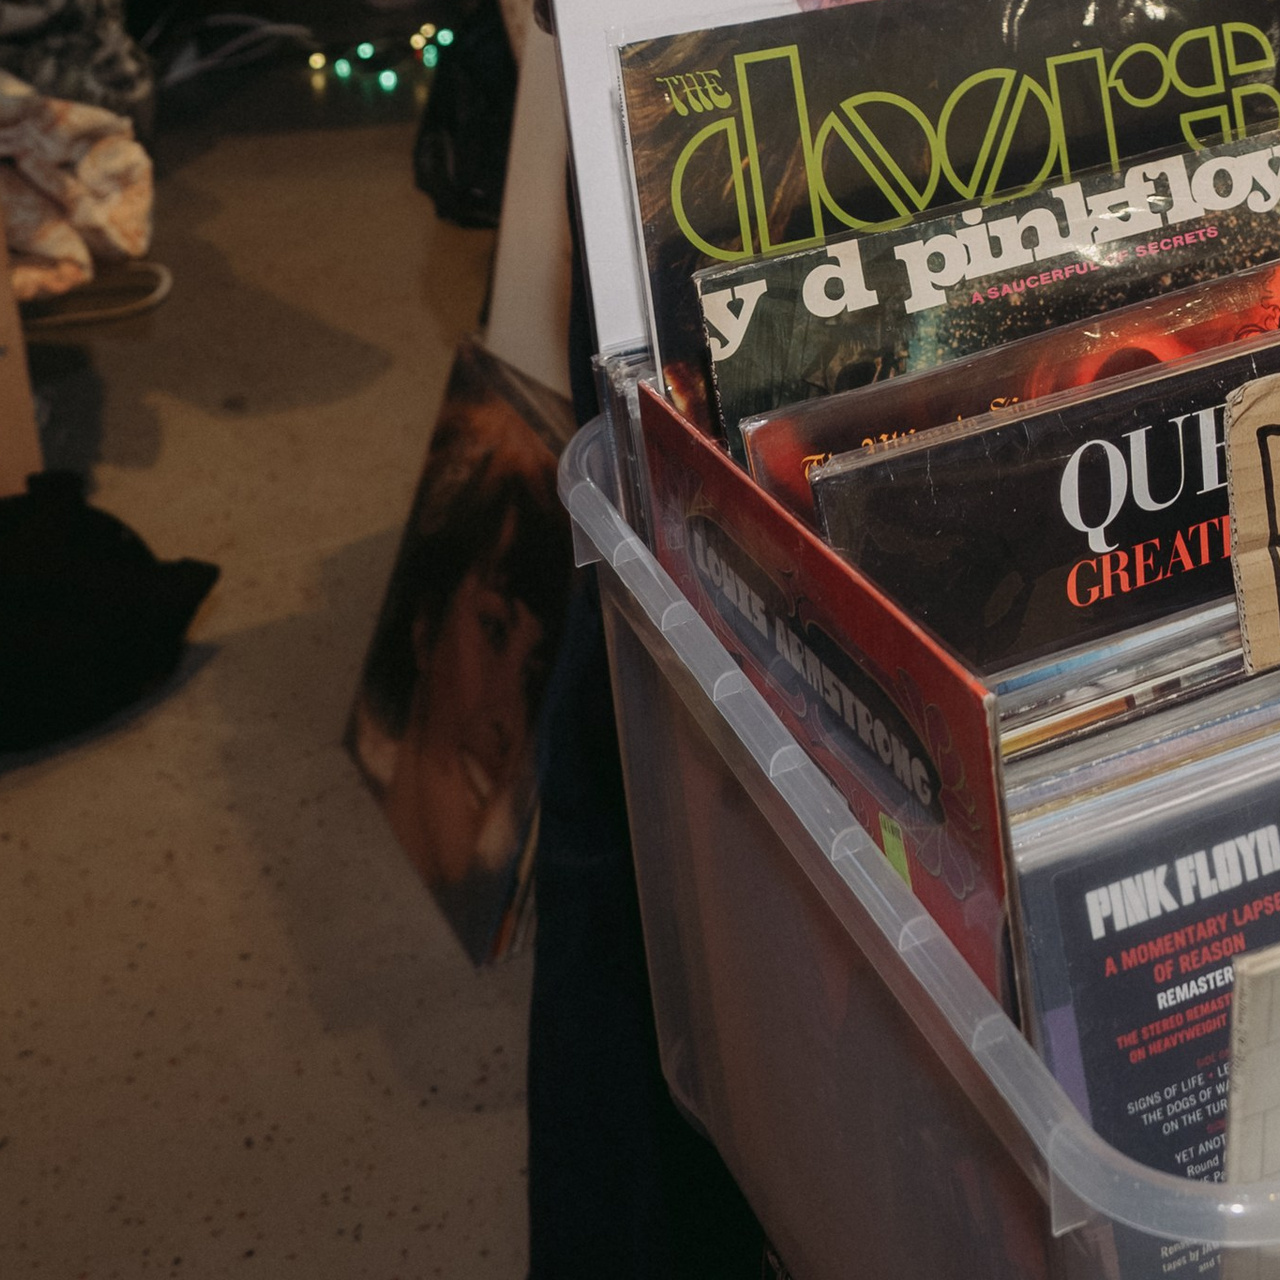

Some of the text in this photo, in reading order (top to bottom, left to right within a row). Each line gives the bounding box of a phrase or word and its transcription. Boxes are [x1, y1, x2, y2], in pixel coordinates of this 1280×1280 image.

[656, 69, 732, 116] THE
[971, 291, 984, 304] A
[987, 261, 1100, 299] SAUCERFUL
[1135, 226, 1218, 257] SECRETS
[1060, 403, 1228, 553] QUE
[1067, 515, 1230, 607] GREAT
[694, 530, 934, 805] LOUIS ARMSTRONG
[1085, 864, 1179, 940] PINK
[1106, 957, 1117, 977] A
[1121, 913, 1227, 970] MOMENTARY
[1154, 932, 1245, 984] OF REASON
[1157, 966, 1234, 1010] REMASTER
[1130, 1013, 1227, 1064] ON HEAVYWEIGHT
[1127, 1073, 1204, 1114] SIGNS OF LIFE
[1141, 1087, 1212, 1125] THE DOGS OF
[1162, 1109, 1203, 1135] ON THE
[1175, 1147, 1195, 1164] YET
